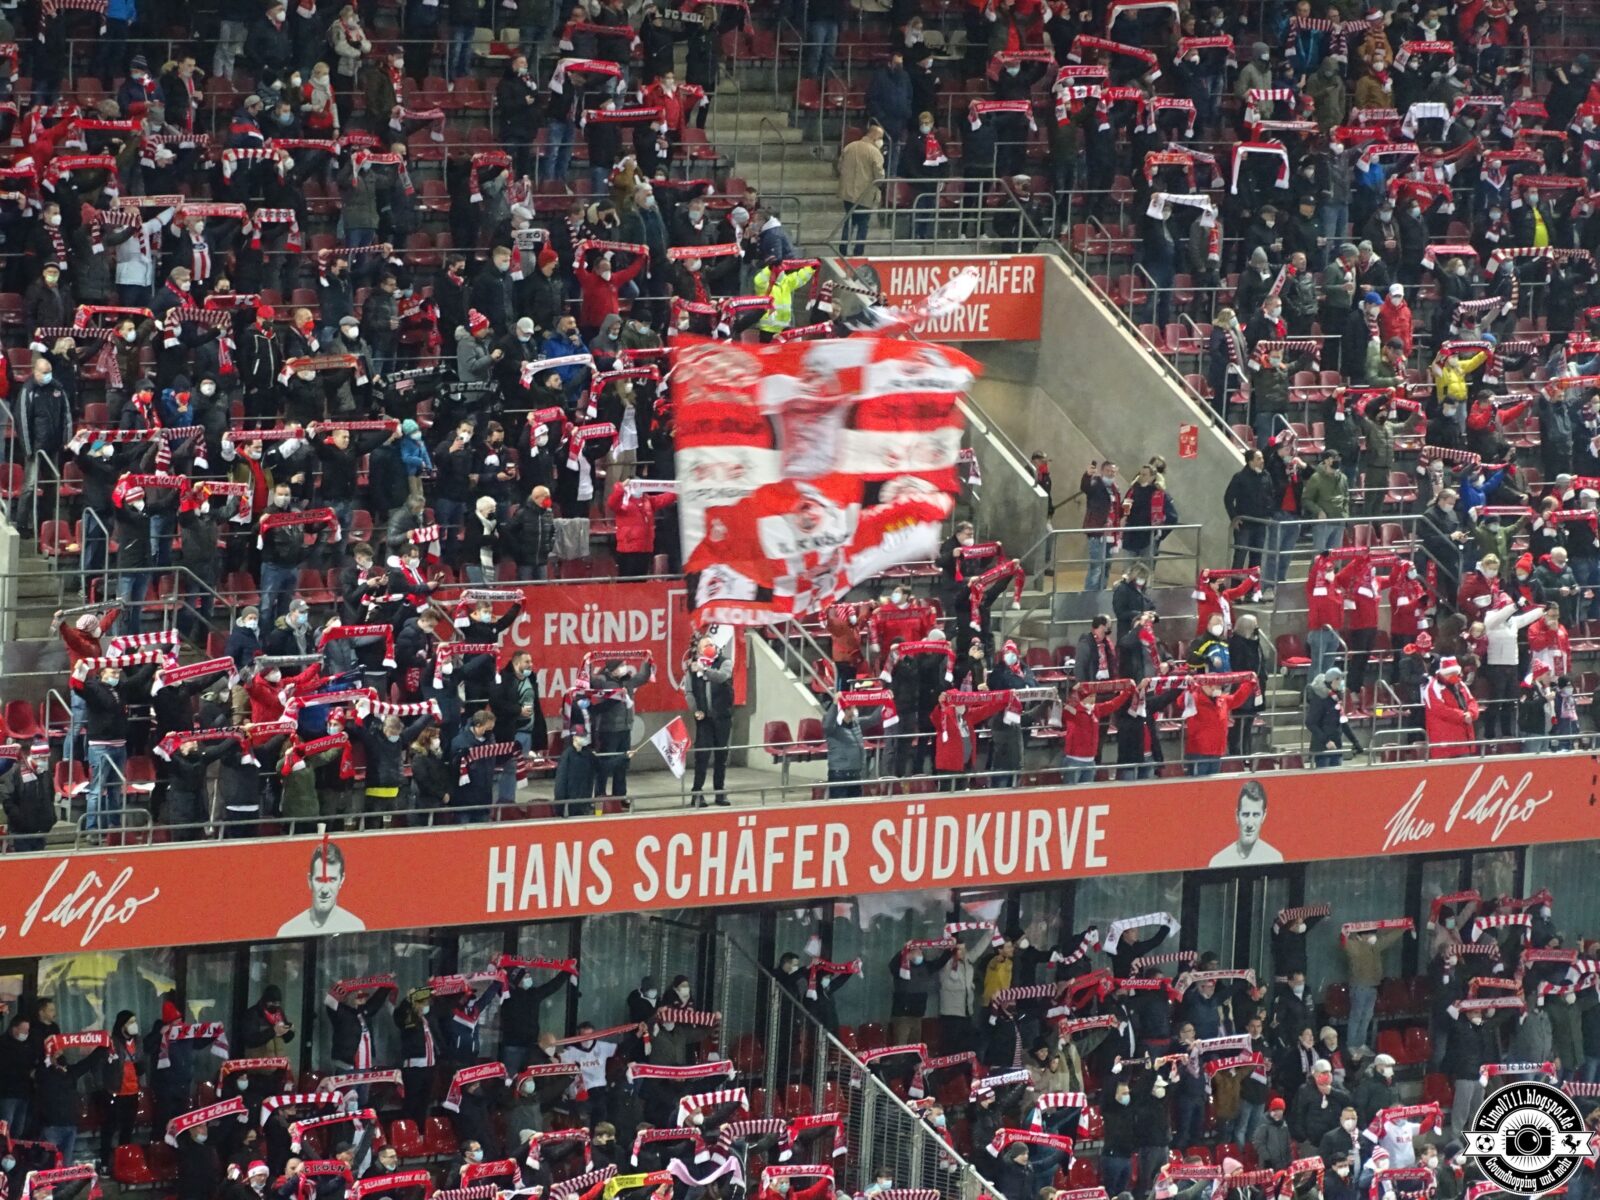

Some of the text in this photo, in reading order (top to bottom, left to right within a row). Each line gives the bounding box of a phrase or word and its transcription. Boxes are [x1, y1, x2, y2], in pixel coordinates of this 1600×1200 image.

[664, 9, 679, 18] FC
[890, 260, 1035, 296] HANS HÄFER
[143, 476, 154, 486] FC
[156, 474, 182, 487] KÖLN
[544, 604, 668, 646] FRÜNDE
[306, 736, 346, 752] DOMSTAD
[486, 803, 1110, 913] HANS SCHÄFER SÜDKURVE
[62, 1033, 102, 1044] 1. FC KÖLN
[240, 1060, 253, 1068] FC
[258, 1057, 287, 1068] KÖLN
[192, 1113, 206, 1122] FC
[208, 1100, 237, 1118] KÖLN
[394, 1176, 412, 1184] STARK
